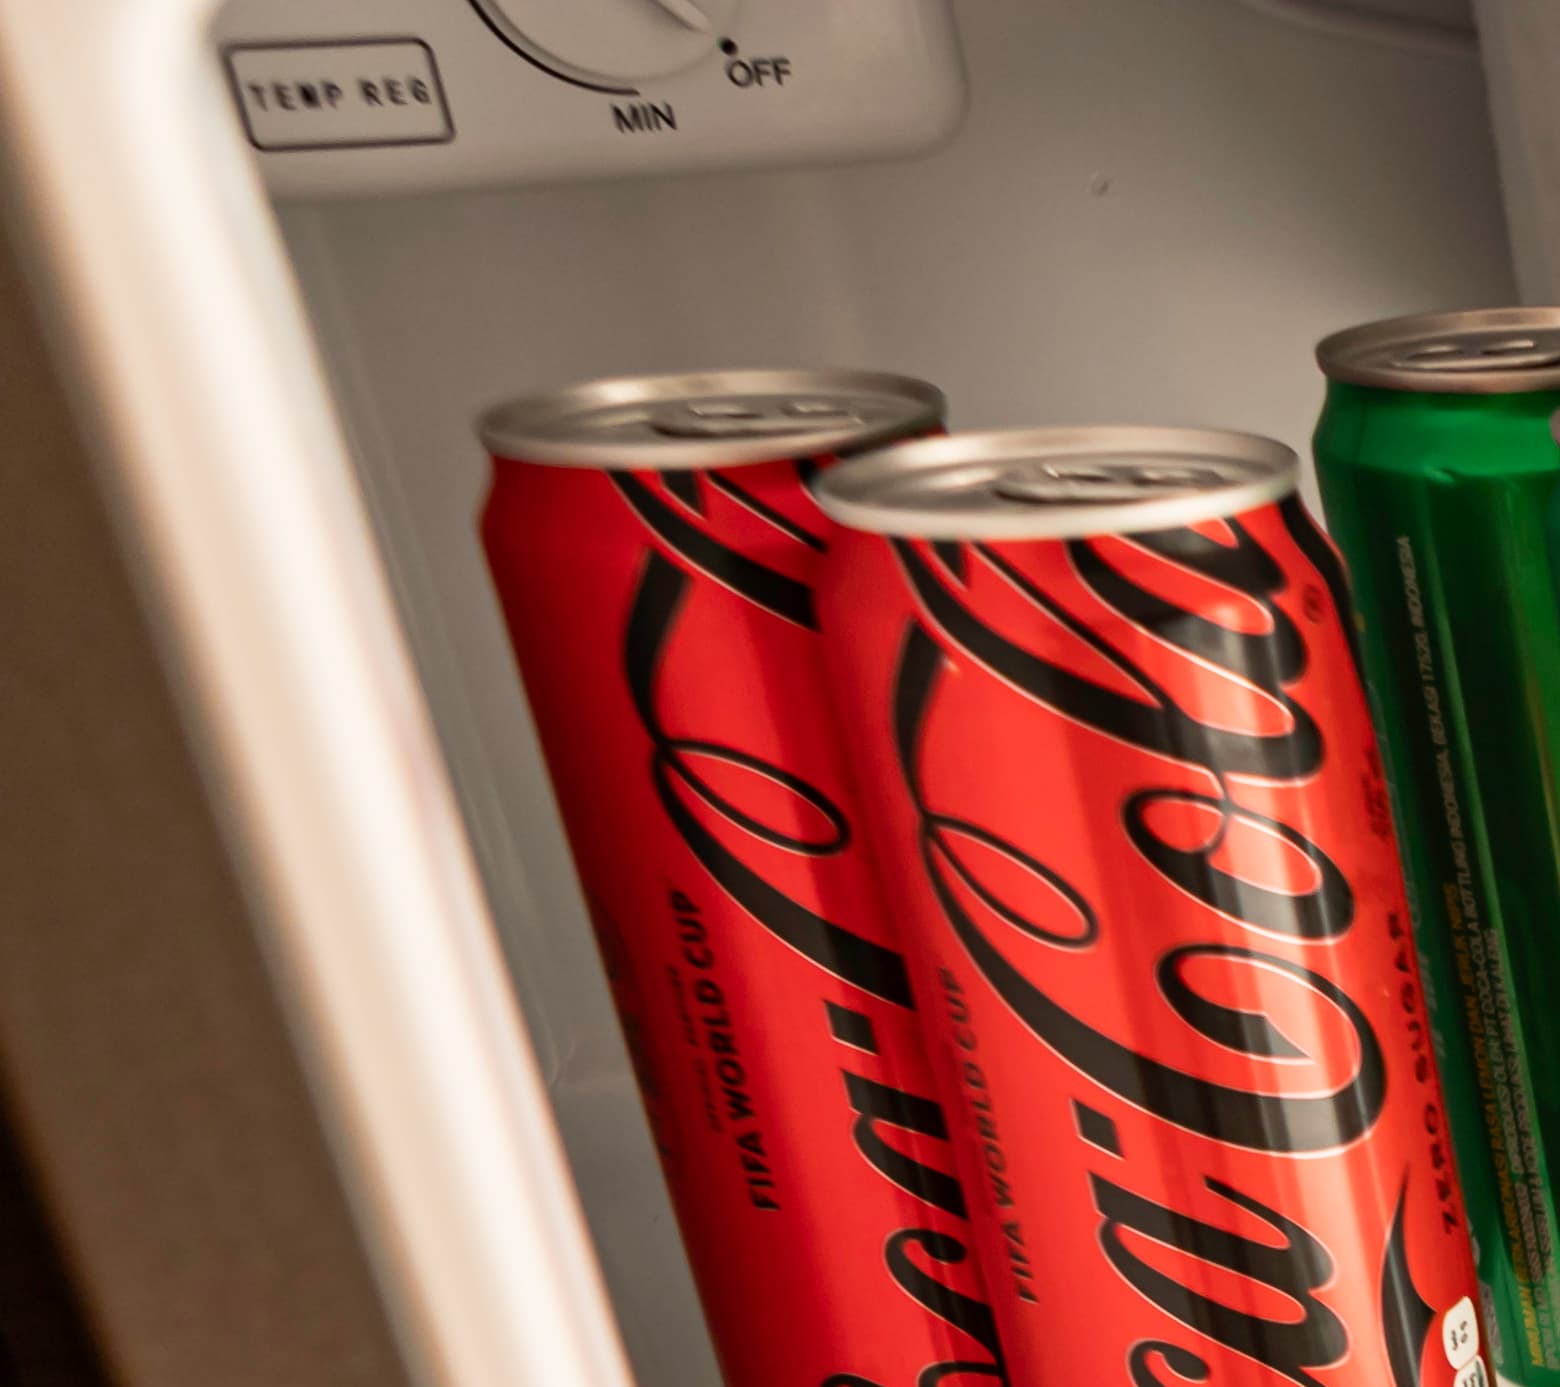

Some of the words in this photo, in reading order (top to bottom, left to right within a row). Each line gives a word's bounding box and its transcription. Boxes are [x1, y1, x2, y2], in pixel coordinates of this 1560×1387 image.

[246, 80, 343, 113] TEMP
[358, 76, 433, 108] REG
[726, 58, 793, 88] OFF
[610, 102, 679, 134] MIN
[671, 890, 715, 968] CUP
[692, 974, 756, 1123] WORLD
[938, 966, 979, 1054] CUP
[732, 1128, 783, 1216] FIFA
[959, 1057, 1014, 1210] WORLD
